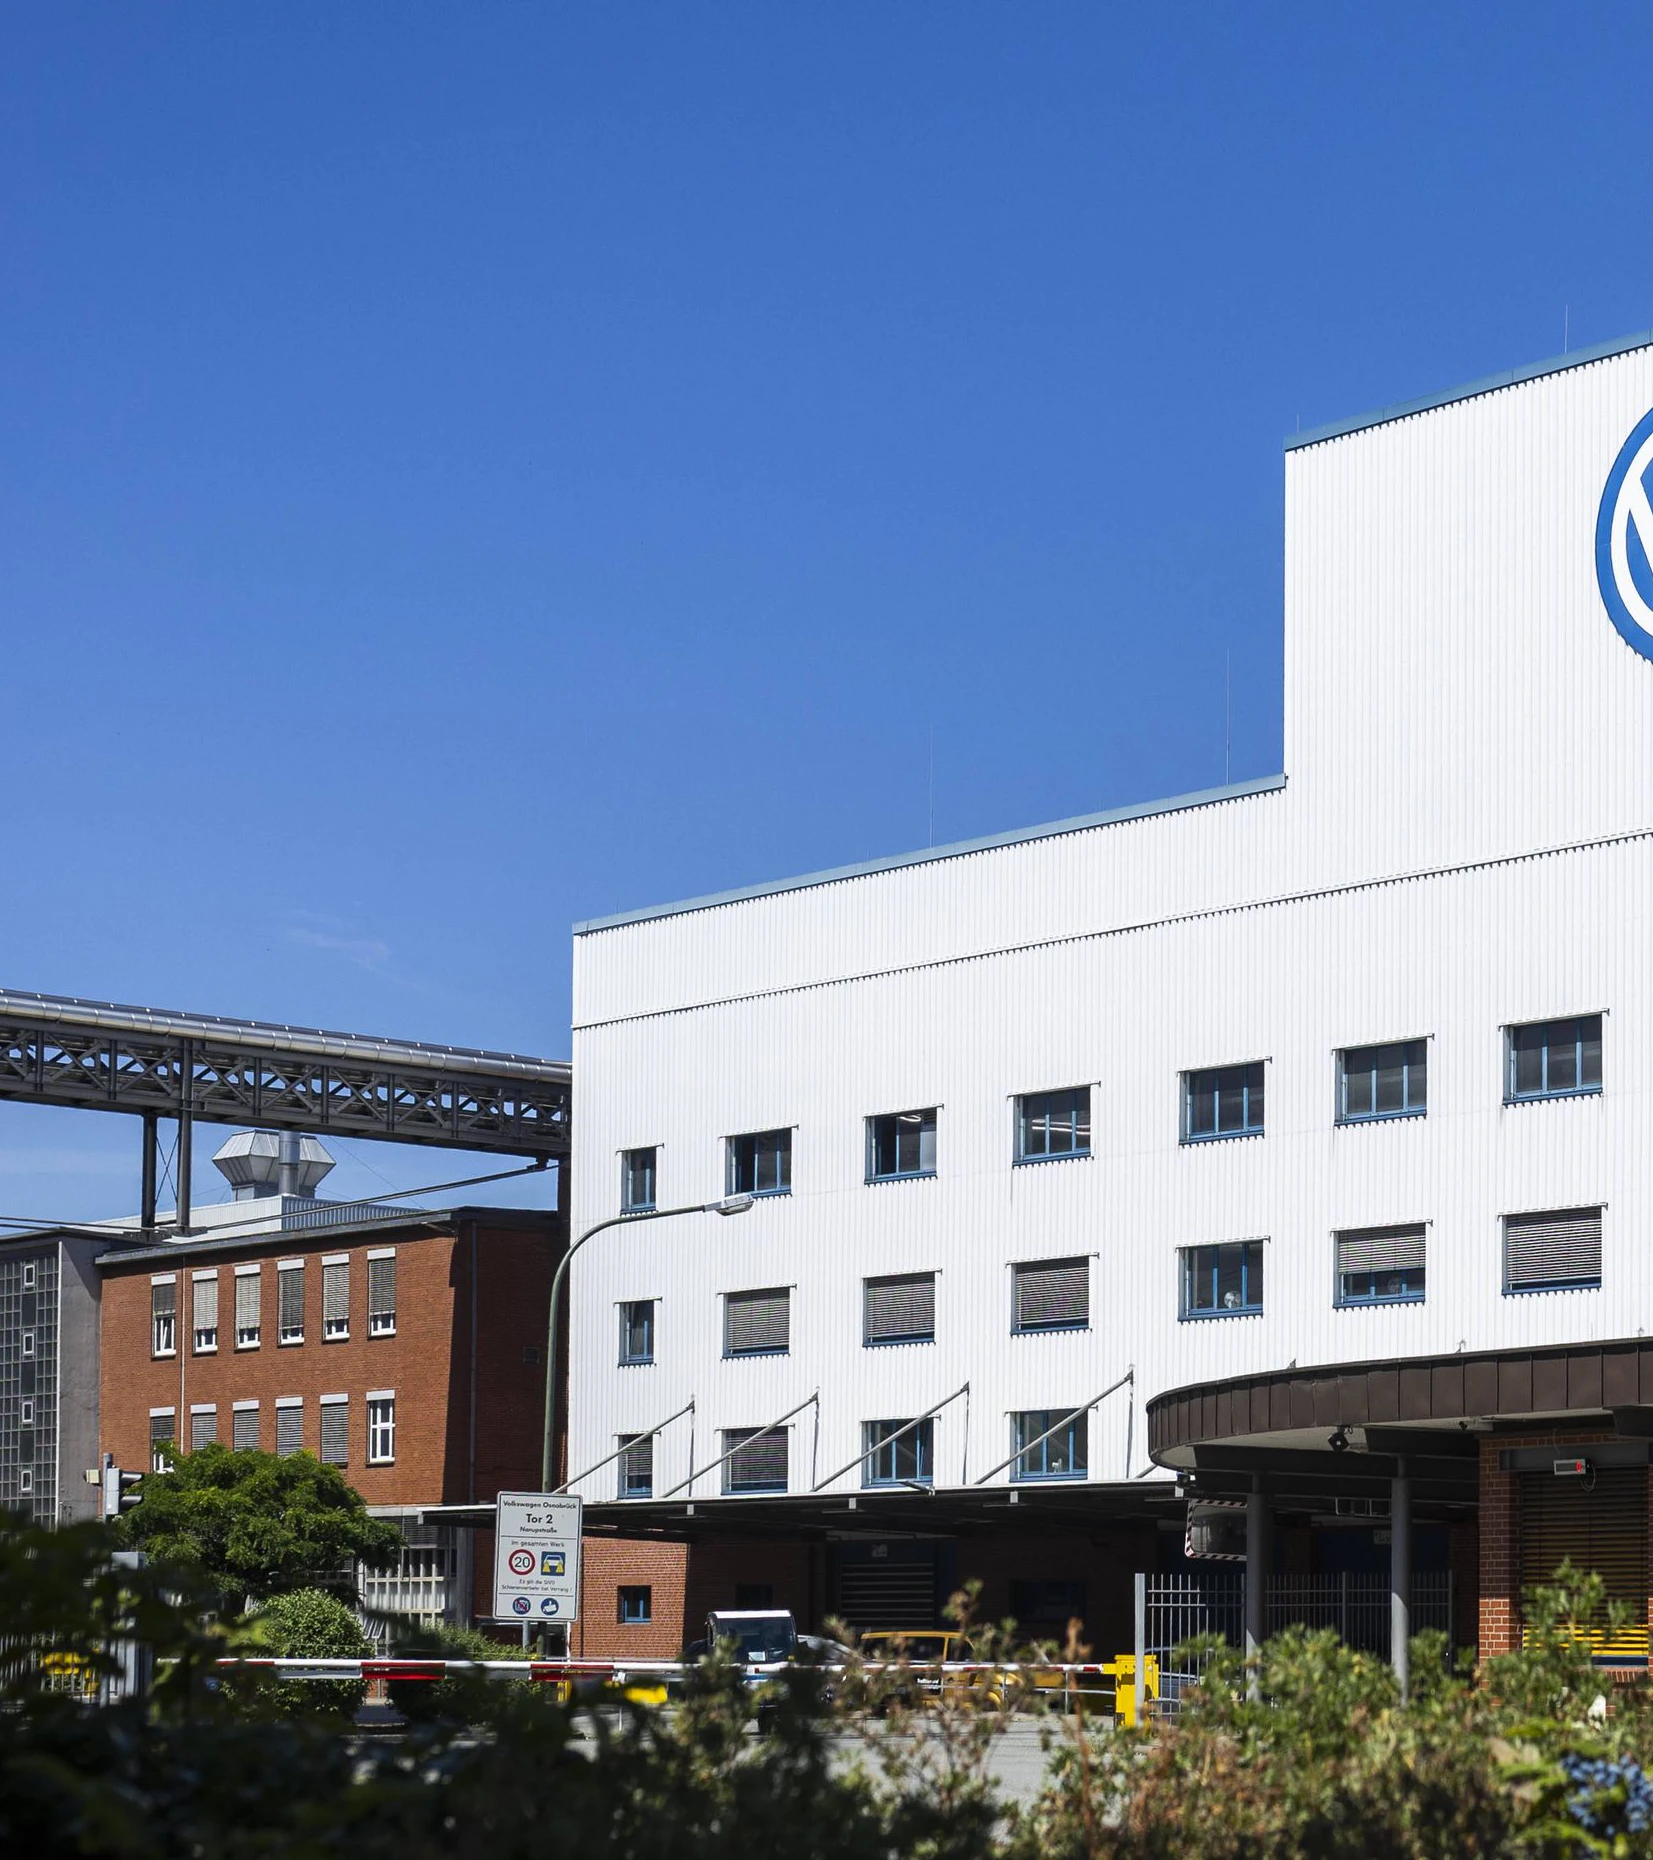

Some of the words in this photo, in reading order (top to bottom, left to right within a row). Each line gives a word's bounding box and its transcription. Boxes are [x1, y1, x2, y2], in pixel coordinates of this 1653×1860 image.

[503, 1500, 541, 1509] Volkswagen
[543, 1501, 577, 1509] Osnabrück
[526, 1513, 542, 1523] Tor
[546, 1514, 553, 1524] 2
[514, 1556, 531, 1568] 20
